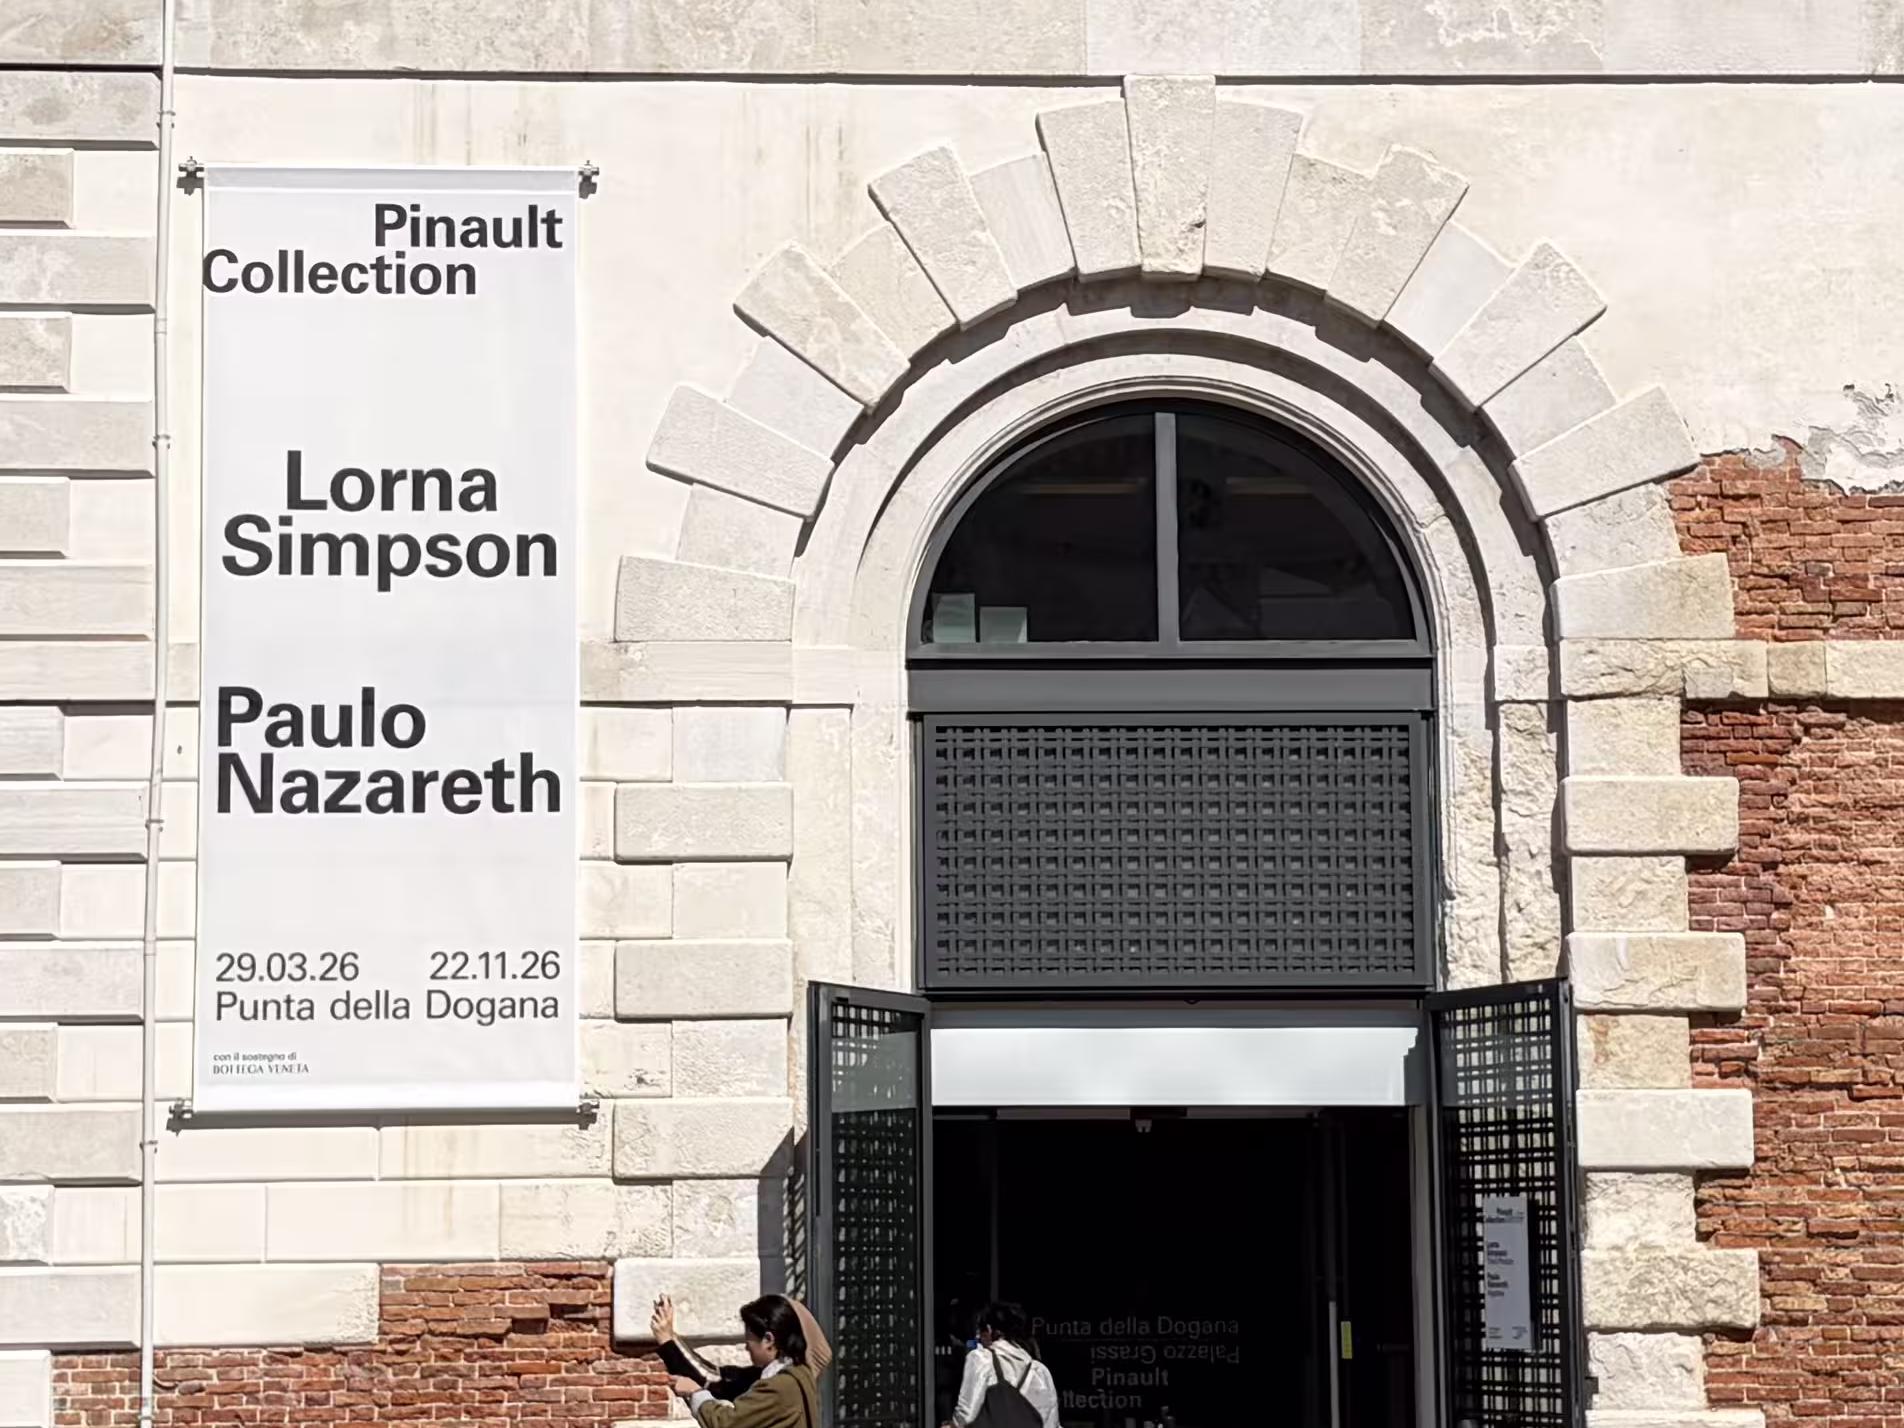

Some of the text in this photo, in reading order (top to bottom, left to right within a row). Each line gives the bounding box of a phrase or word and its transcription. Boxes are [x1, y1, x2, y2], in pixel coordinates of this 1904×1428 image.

[374, 203, 563, 249] Pinault
[203, 249, 477, 296] Collection
[286, 450, 498, 513] Lorna
[222, 514, 558, 593] Simpson
[217, 686, 426, 749] Paulo
[217, 752, 561, 815] Nazareth
[215, 950, 561, 983] 29.03.26 22.11.26
[216, 989, 559, 1027] Punta della Dogana
[213, 1054, 232, 1062] con
[1031, 1315, 1240, 1339] Punta della Dogana
[1089, 1345, 1240, 1365] Palazzo Grassi
[1091, 1366, 1170, 1387] Pinault
[1057, 1389, 1143, 1409] llection
